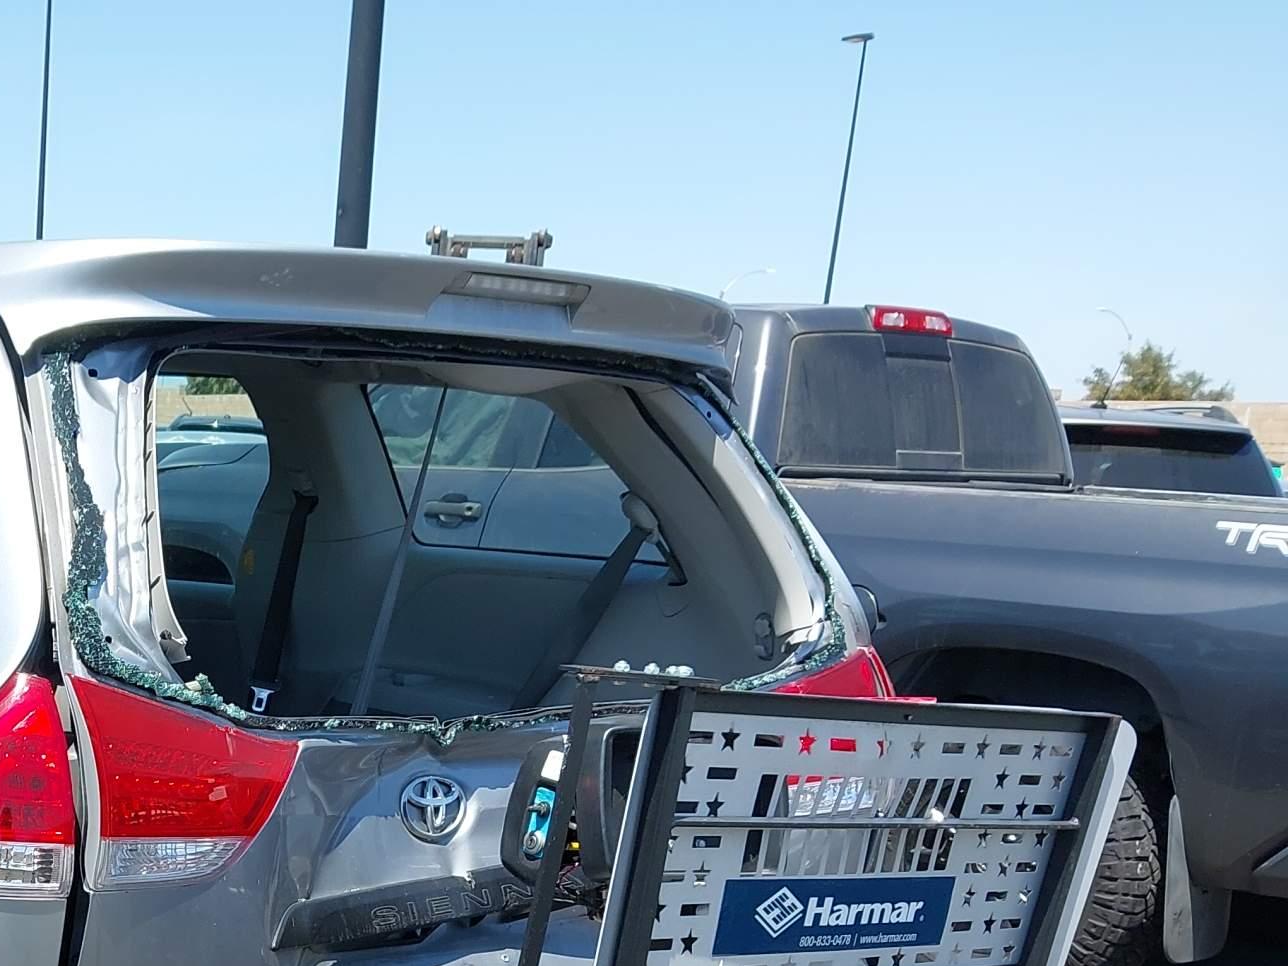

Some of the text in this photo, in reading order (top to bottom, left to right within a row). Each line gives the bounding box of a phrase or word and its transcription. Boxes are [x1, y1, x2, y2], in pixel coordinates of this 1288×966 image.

[803, 896, 924, 927] Harmar
[799, 934, 851, 948] 800-833-0478
[860, 932, 917, 945] www.harmar.com
